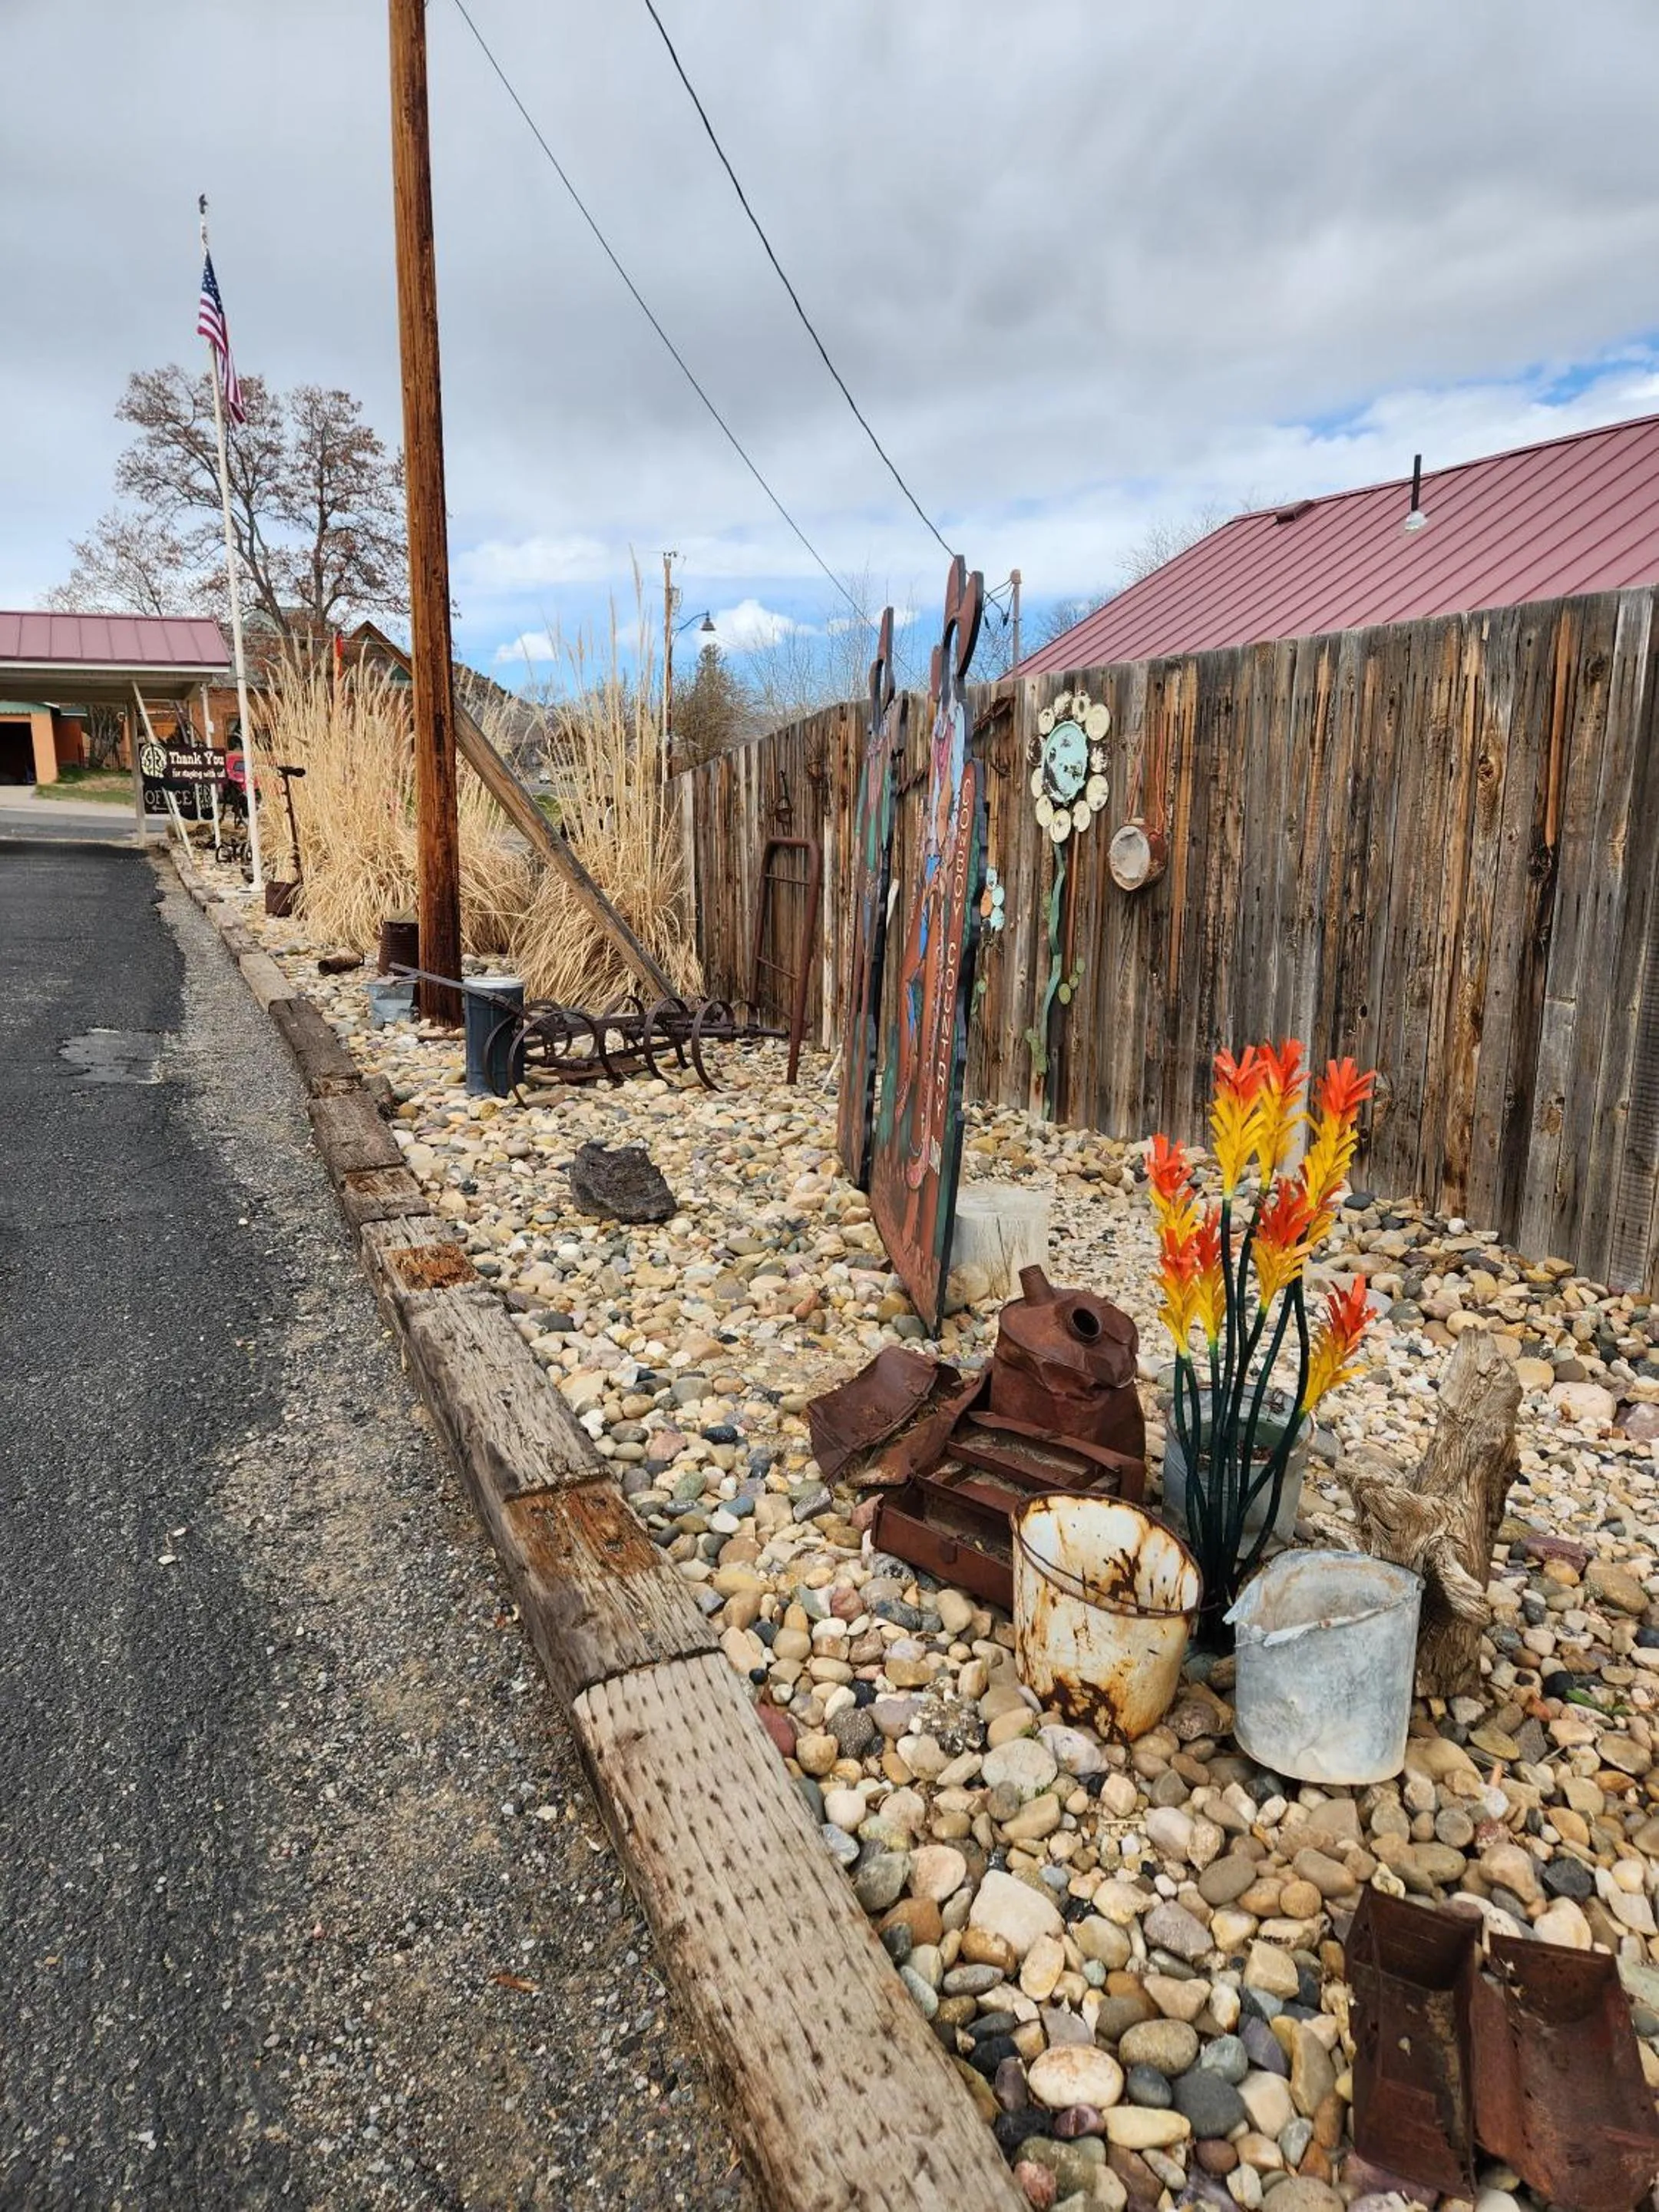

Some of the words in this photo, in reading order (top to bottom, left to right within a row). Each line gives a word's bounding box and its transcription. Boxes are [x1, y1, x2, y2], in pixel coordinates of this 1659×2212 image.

[169, 752, 202, 765] Thank
[203, 751, 224, 765] You
[172, 768, 180, 777] for
[145, 789, 193, 805] OFCE
[953, 779, 971, 920] COWBOY
[937, 942, 957, 1117] COUNTRY
